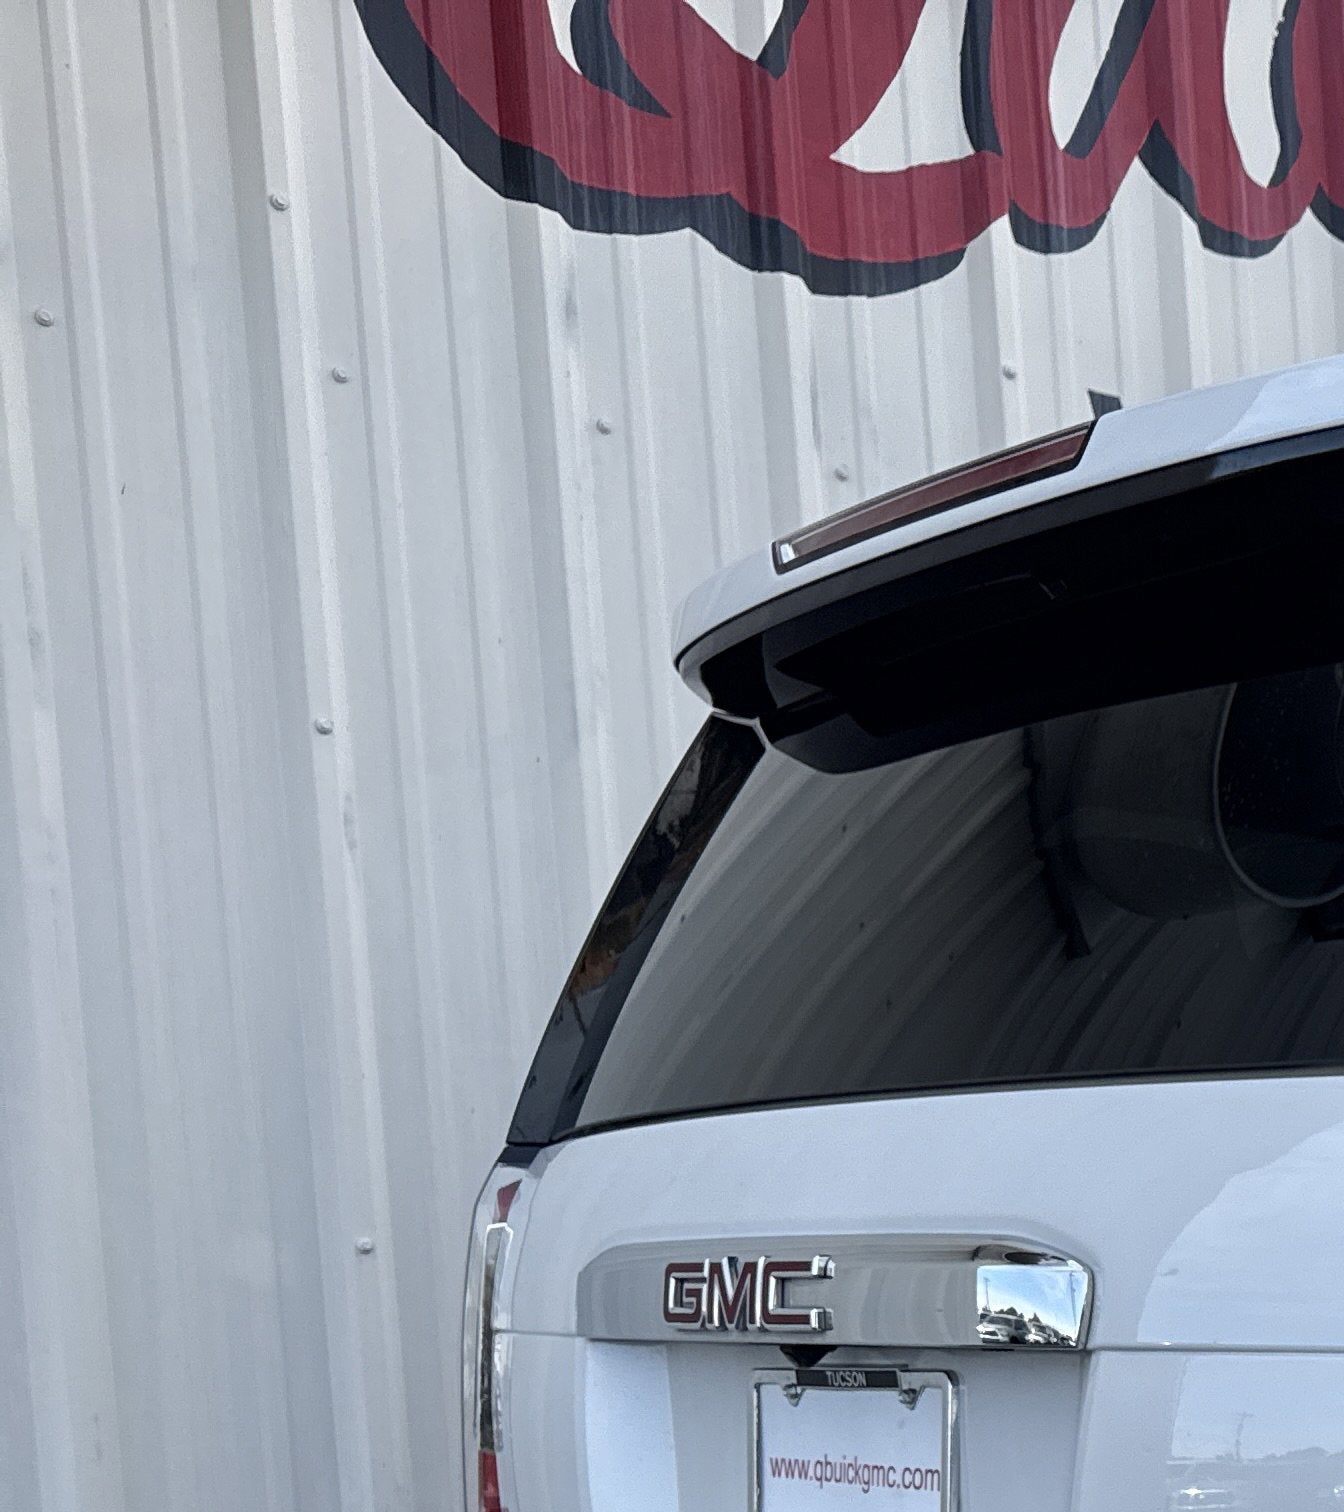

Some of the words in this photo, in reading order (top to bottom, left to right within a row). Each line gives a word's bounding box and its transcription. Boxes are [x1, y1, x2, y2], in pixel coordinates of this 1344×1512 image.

[663, 1254, 835, 1332] GMC
[826, 1370, 868, 1388] TUCSON
[769, 1454, 941, 1494] www.qbuickgmc.com
